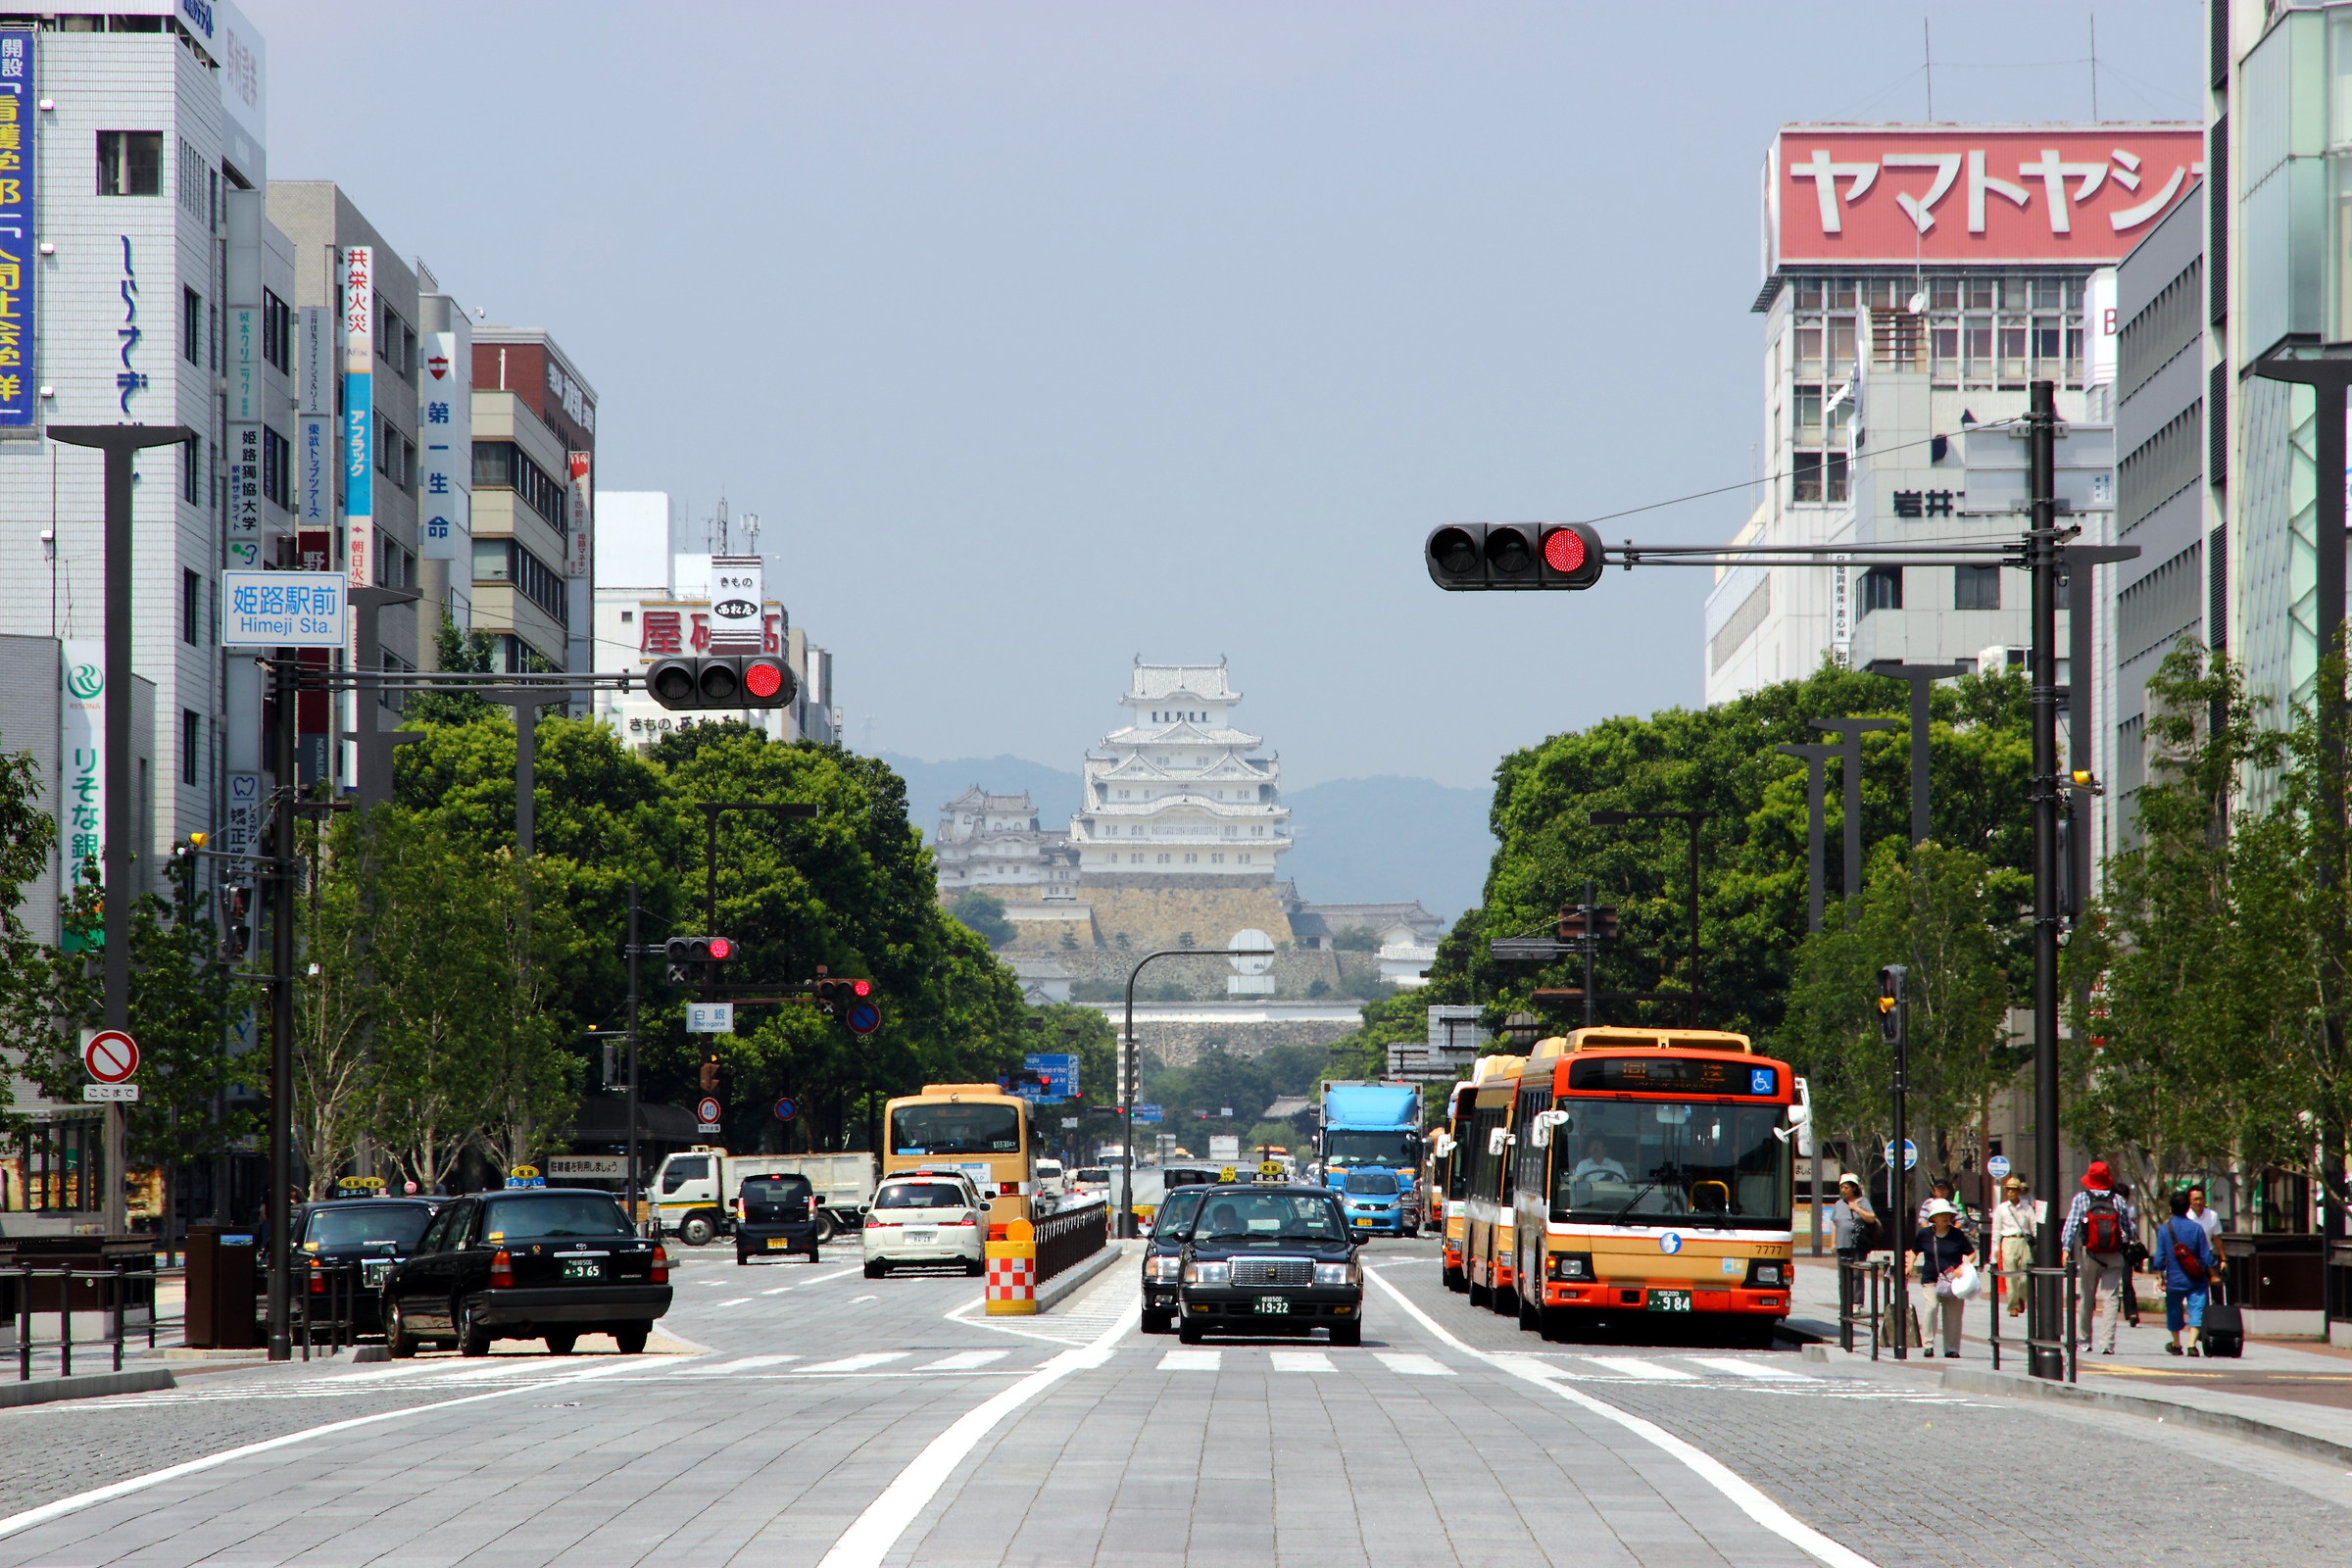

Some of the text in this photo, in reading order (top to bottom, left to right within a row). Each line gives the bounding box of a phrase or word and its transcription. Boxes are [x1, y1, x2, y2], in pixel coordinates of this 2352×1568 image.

[1790, 149, 2203, 233] ヤマトヤシ
[348, 250, 368, 333] 共栄火災
[117, 235, 148, 425] しらさぎ
[351, 411, 366, 477] アフラック
[242, 430, 257, 530] 姫路獨協大学
[309, 423, 320, 517] 東武トップツアーズ
[428, 402, 449, 539] 第一生命
[720, 576, 753, 587] きもの
[233, 586, 336, 615] 姫路駅前
[241, 617, 332, 636] Himeji Sta.
[629, 718, 671, 731] きもの
[89, 1089, 133, 1098] ここまで
[704, 1105, 715, 1116] 40
[1755, 1246, 1783, 1254] 7777
[1261, 1302, 1289, 1313] 19-22
